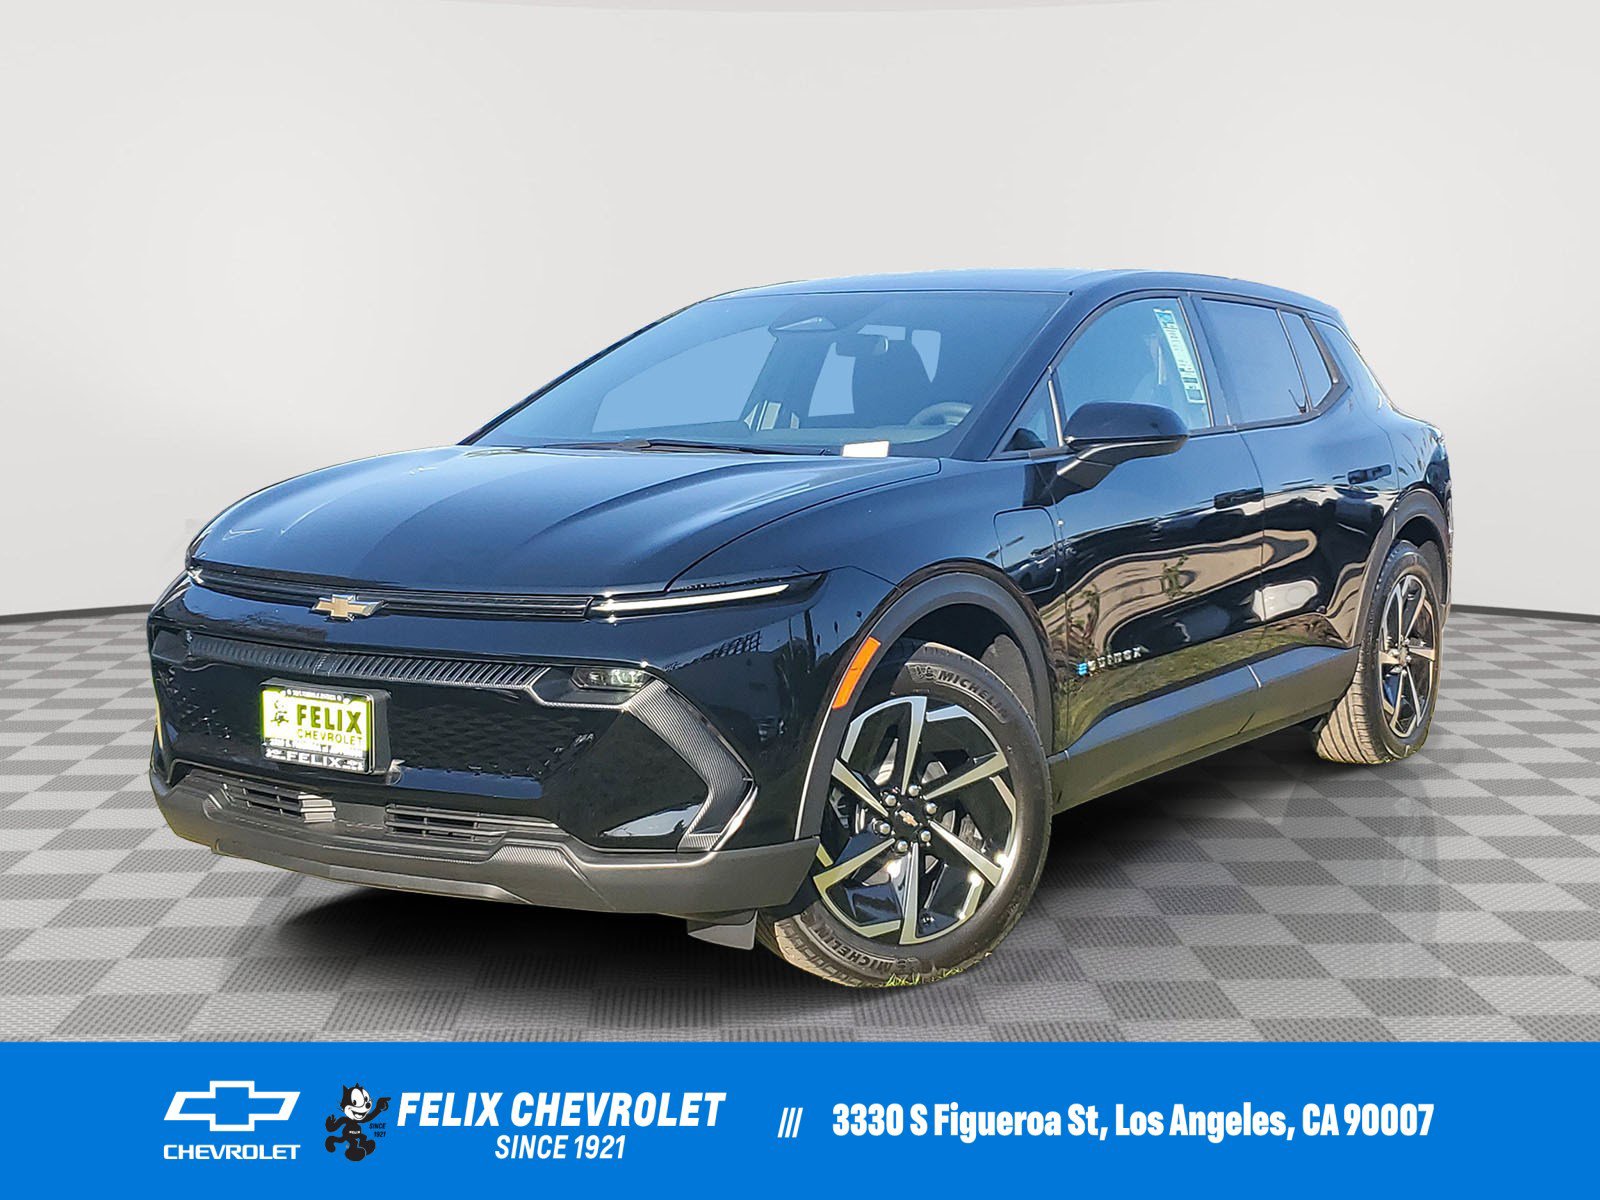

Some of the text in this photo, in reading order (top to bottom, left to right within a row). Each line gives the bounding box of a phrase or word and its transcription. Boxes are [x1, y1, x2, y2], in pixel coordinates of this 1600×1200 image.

[296, 703, 362, 735] FELIX
[296, 728, 363, 745] CHEVROLET
[285, 750, 342, 768] FELIX
